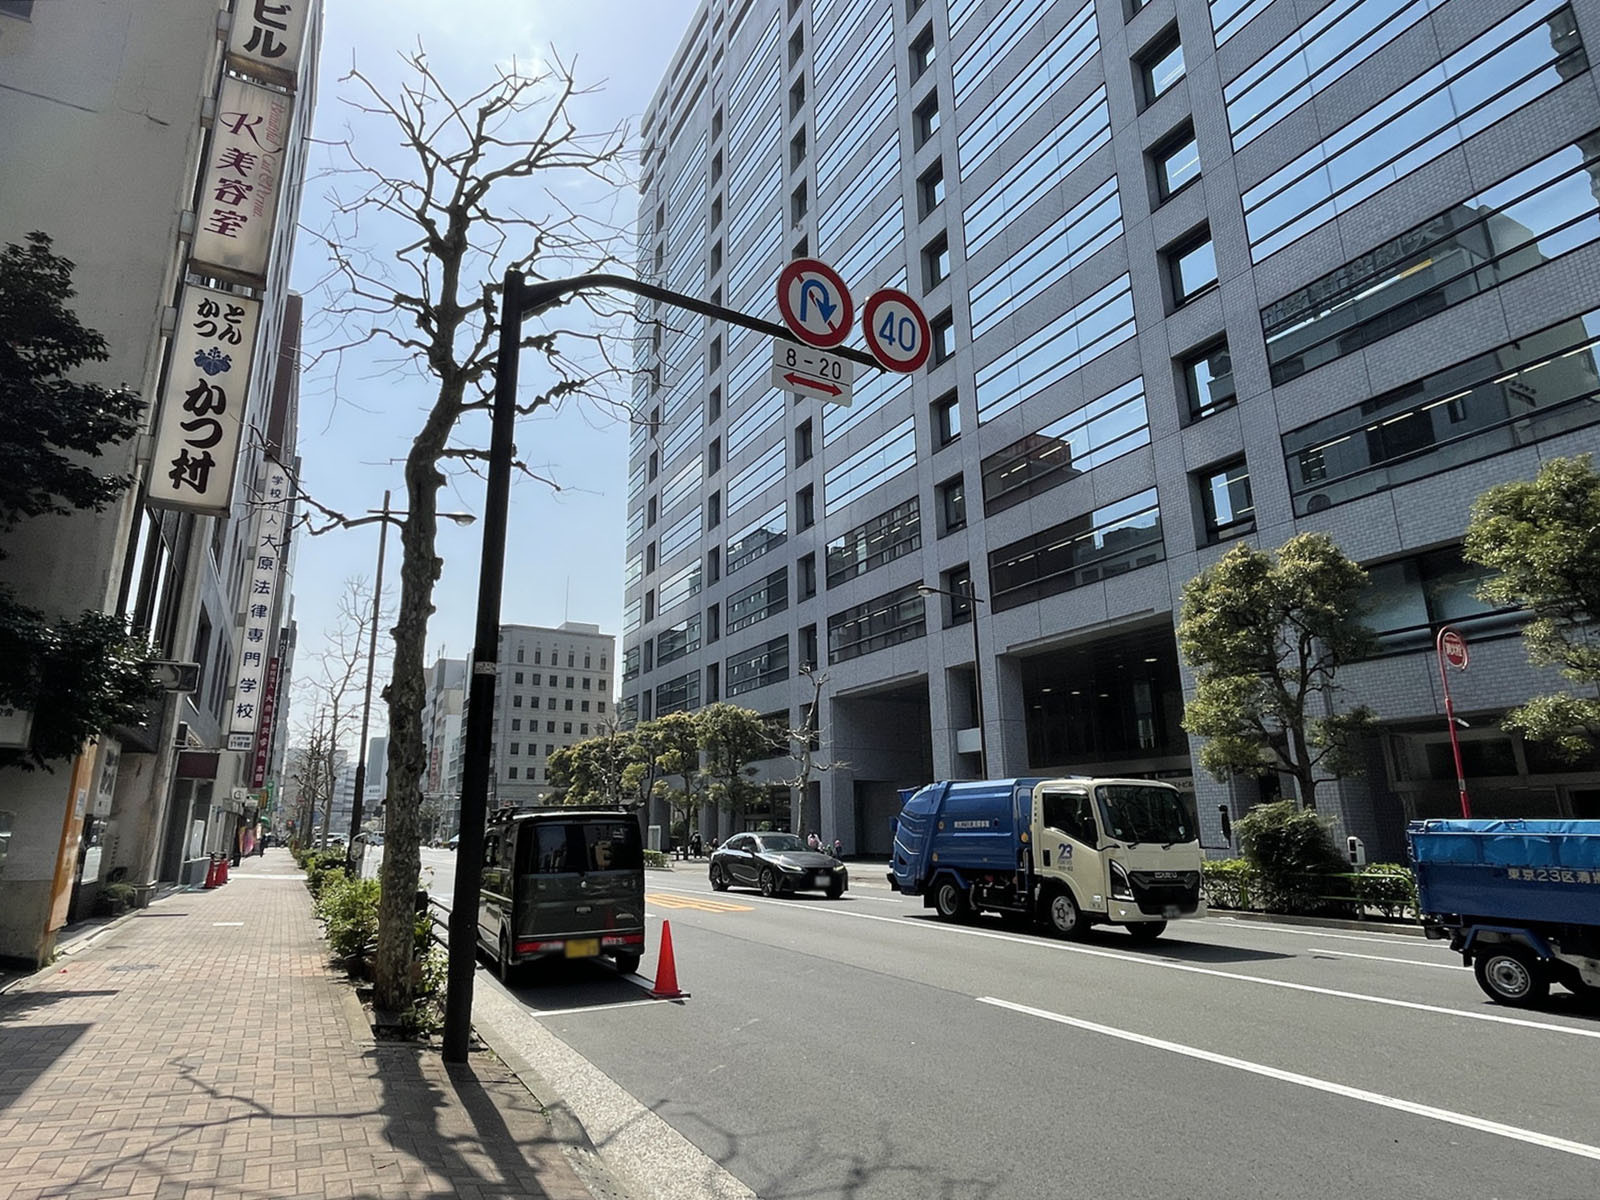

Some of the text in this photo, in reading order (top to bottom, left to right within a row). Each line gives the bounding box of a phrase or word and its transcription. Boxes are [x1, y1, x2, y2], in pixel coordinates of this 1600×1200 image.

[242, 0, 291, 58] ビル
[878, 311, 916, 352] 40
[168, 378, 227, 494] かつ村
[1058, 843, 1073, 860] 23
